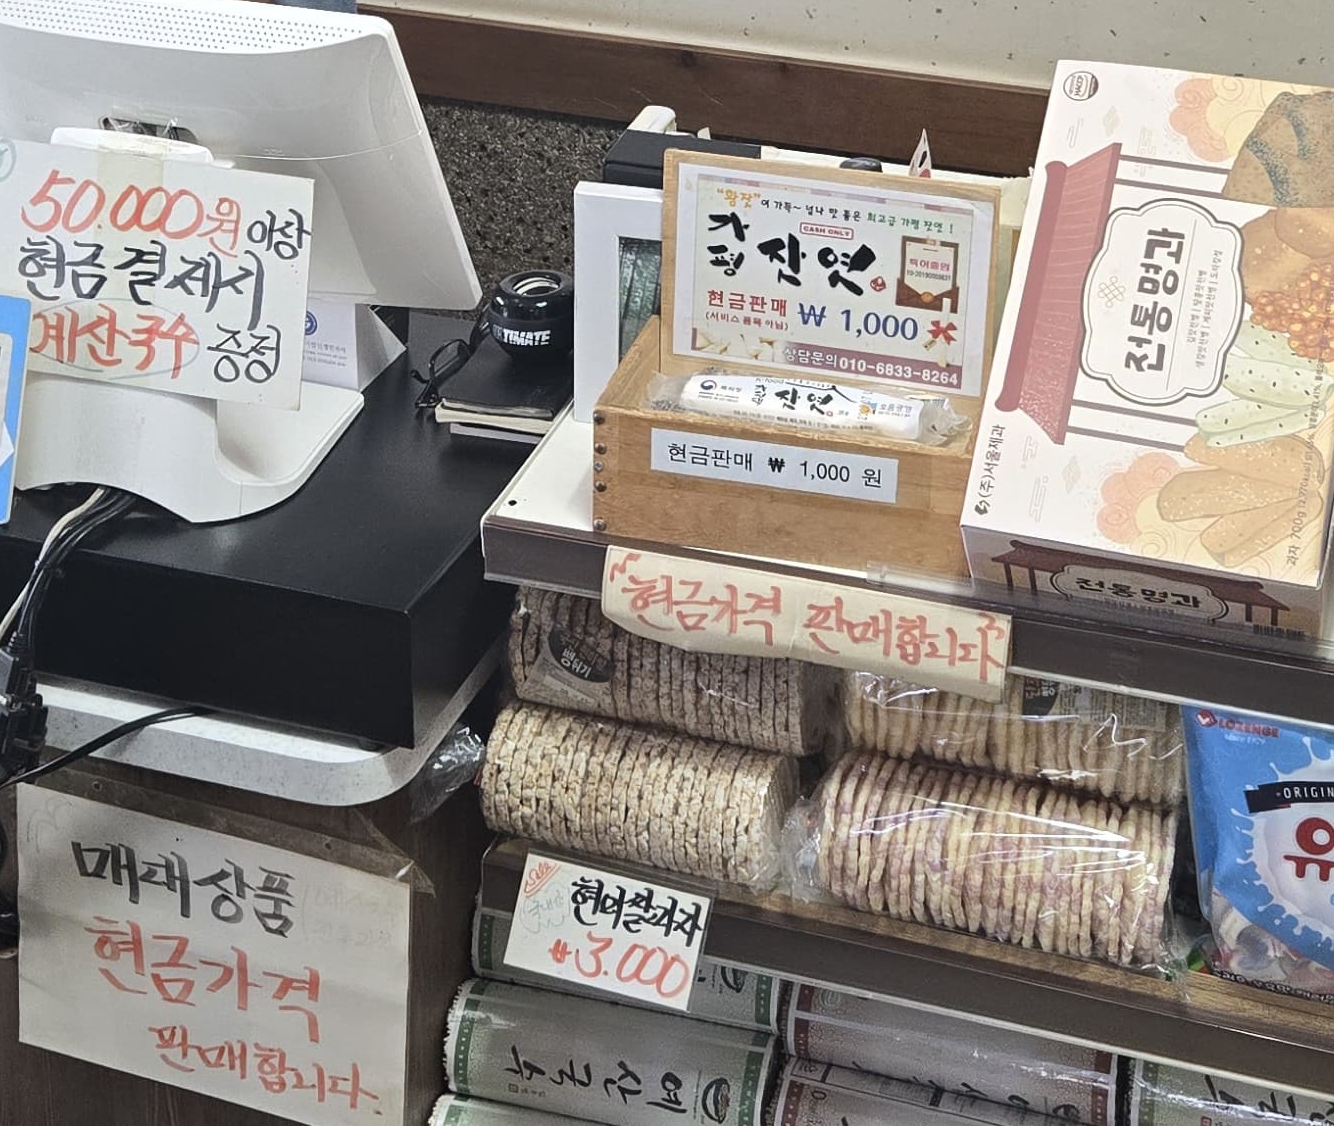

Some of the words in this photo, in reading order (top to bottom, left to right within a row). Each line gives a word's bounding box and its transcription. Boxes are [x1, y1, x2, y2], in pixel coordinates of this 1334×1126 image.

[20, 168, 243, 257] 50.000원
[245, 208, 312, 260] 이상
[803, 225, 825, 235] CASH
[827, 228, 851, 238] ONLY
[18, 235, 110, 301] 현금
[1123, 227, 1186, 373] 전통명과
[707, 289, 788, 317] 현금판매
[797, 302, 827, 328] ₩
[841, 308, 919, 341] 1,000
[205, 322, 283, 384] 증정
[783, 348, 837, 369] 상담문의
[839, 356, 959, 387] 010-6833-8264
[667, 442, 754, 473] 현금판매
[768, 457, 786, 473] ₩
[799, 460, 851, 484] 1,000
[862, 468, 882, 489] 원
[982, 423, 1007, 506] (주)서울제과
[1076, 575, 1201, 610] 전통명과
[621, 571, 783, 645] 현금가격
[803, 600, 1008, 684] 판매합니다
[570, 875, 703, 948] 현미쌀과자
[82, 914, 321, 1043] 현금가격
